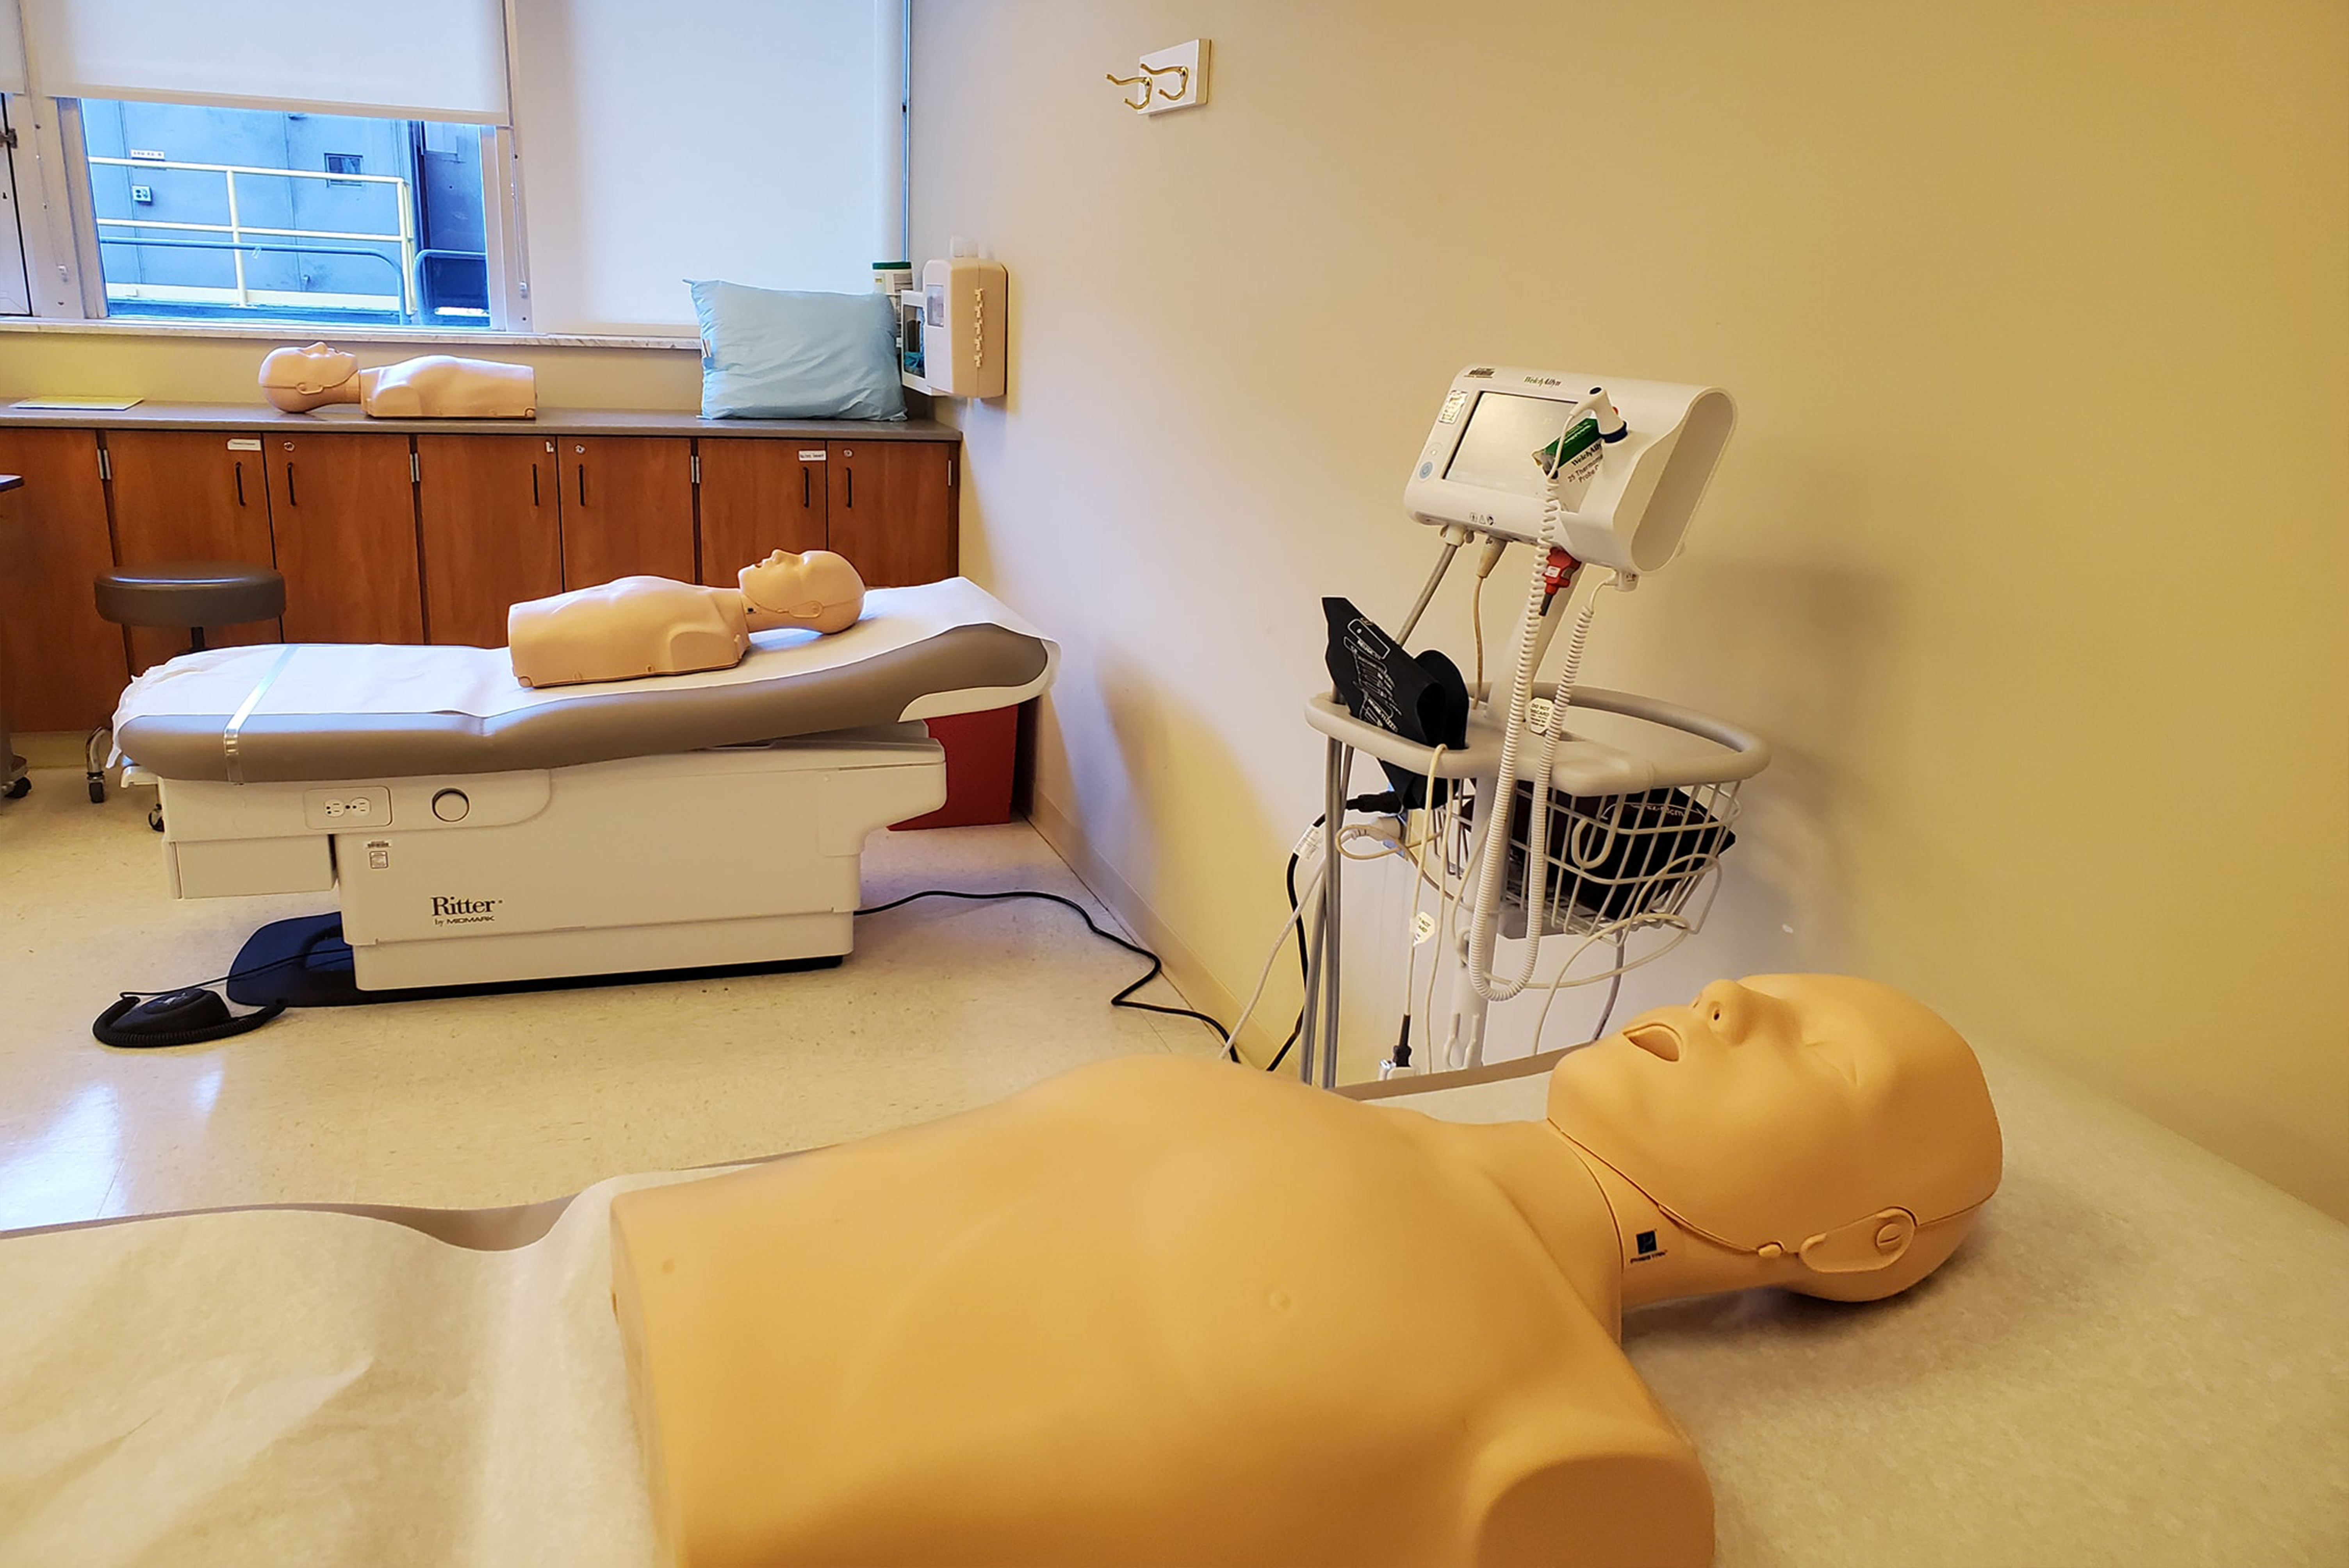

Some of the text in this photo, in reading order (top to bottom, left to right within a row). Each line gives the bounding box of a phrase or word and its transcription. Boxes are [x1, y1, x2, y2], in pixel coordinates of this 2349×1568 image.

[1568, 474, 1576, 483] 25
[430, 896, 495, 916] Ritter
[435, 916, 495, 927] by MIDMARK
